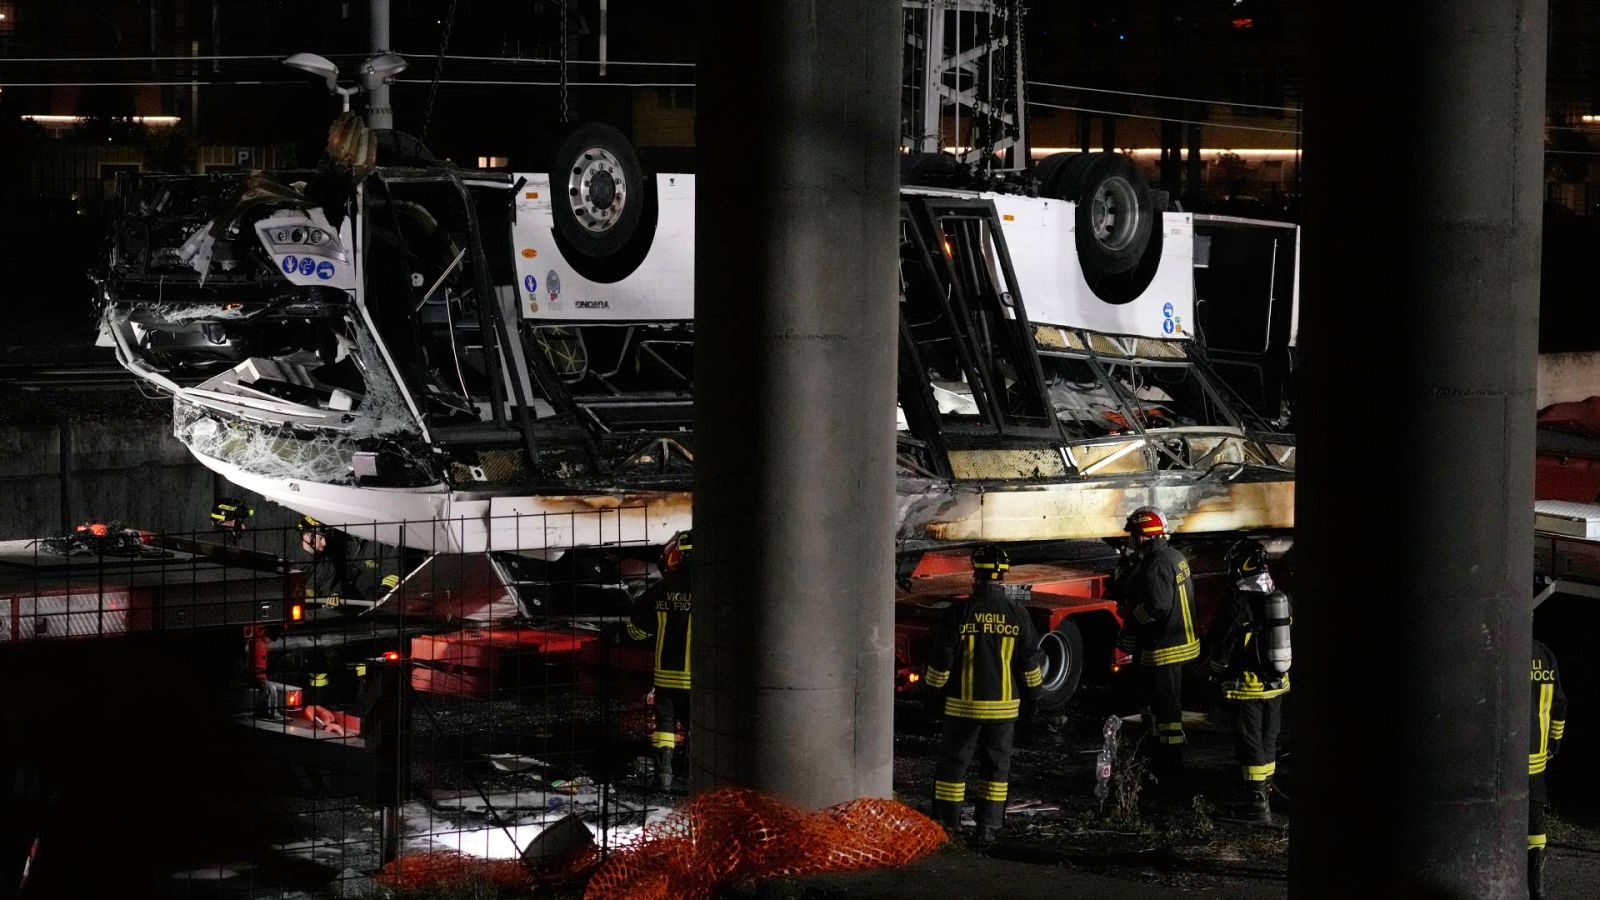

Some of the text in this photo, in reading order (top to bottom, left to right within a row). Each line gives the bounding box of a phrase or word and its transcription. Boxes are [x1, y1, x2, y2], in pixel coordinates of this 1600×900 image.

[238, 150, 249, 165] P
[974, 612, 1006, 624] VIGILI
[983, 623, 1020, 636] FUOCO
[1532, 659, 1542, 670] LI
